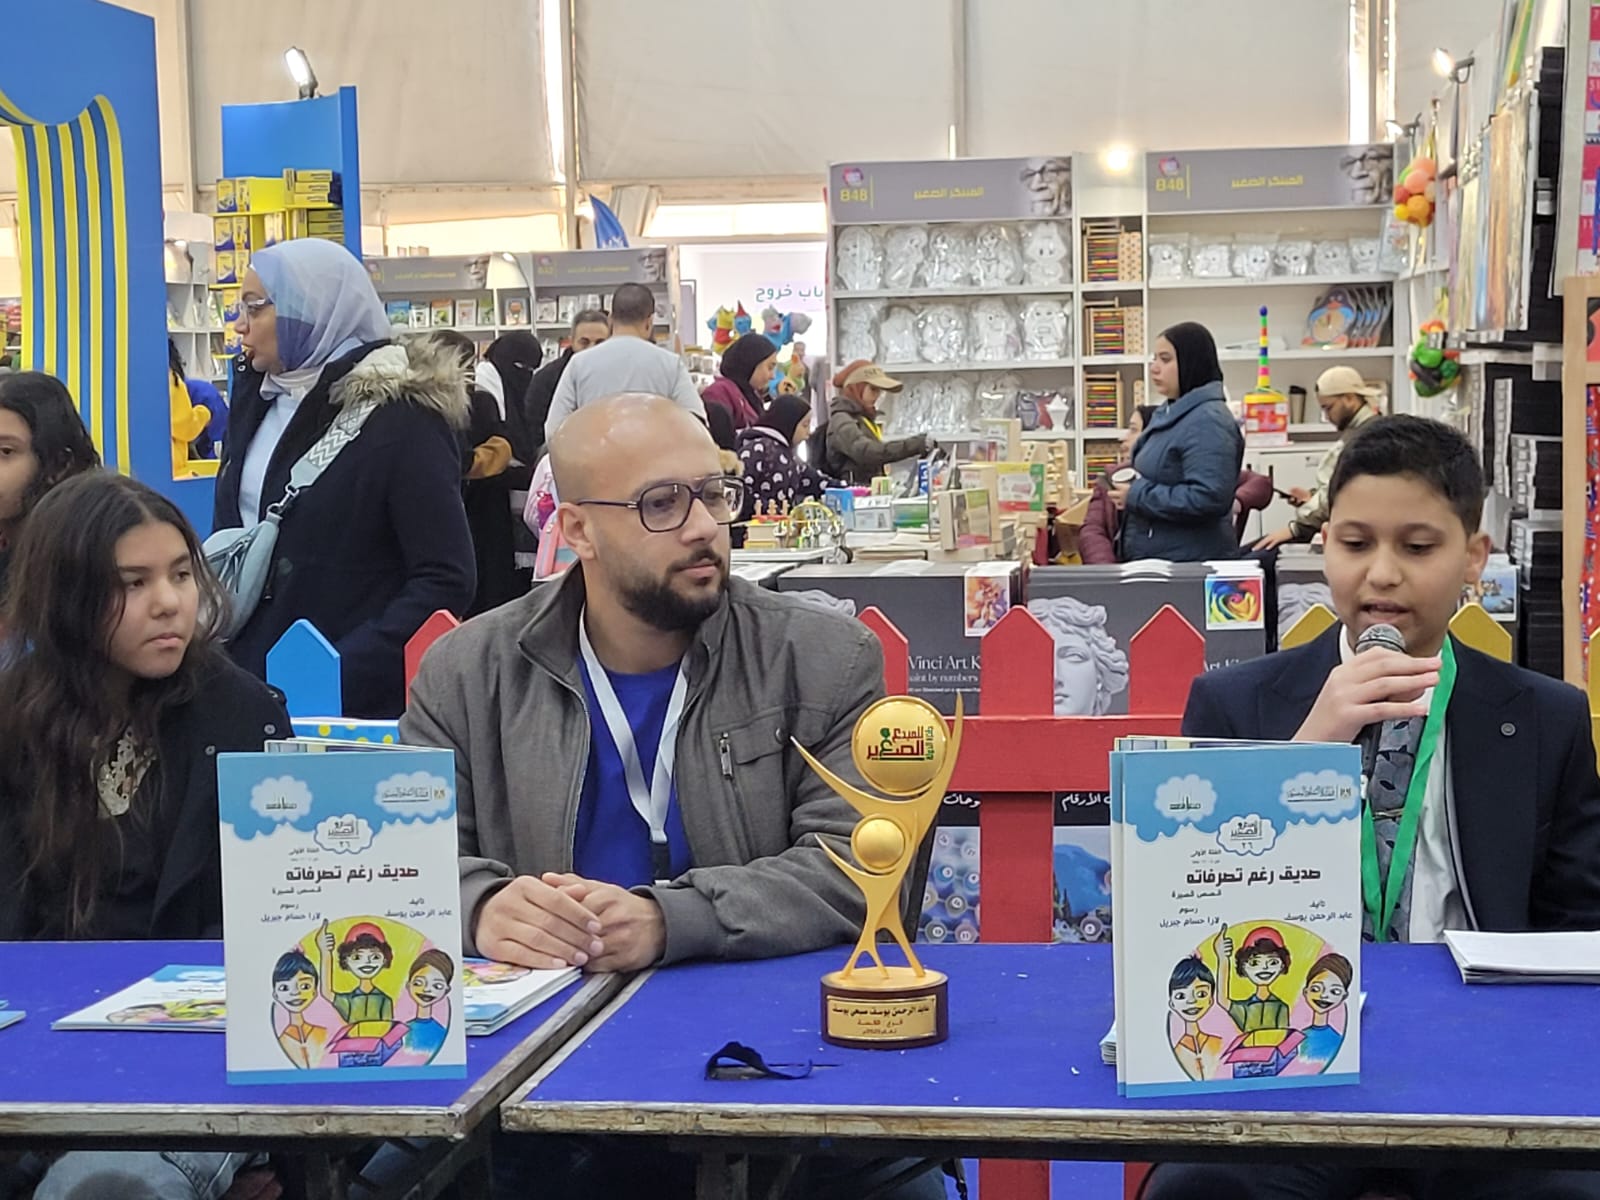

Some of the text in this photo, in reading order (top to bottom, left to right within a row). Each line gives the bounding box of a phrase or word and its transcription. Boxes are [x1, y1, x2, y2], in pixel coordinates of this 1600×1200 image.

[840, 188, 868, 202] B48
[755, 283, 823, 303] باب خروج
[908, 655, 982, 669] Vinci Art K
[940, 673, 978, 682] numbers
[943, 793, 981, 808] وحات
[286, 864, 419, 884] صديق رغم تصرفاته
[1187, 866, 1321, 887] صديق رغم تصرفاته
